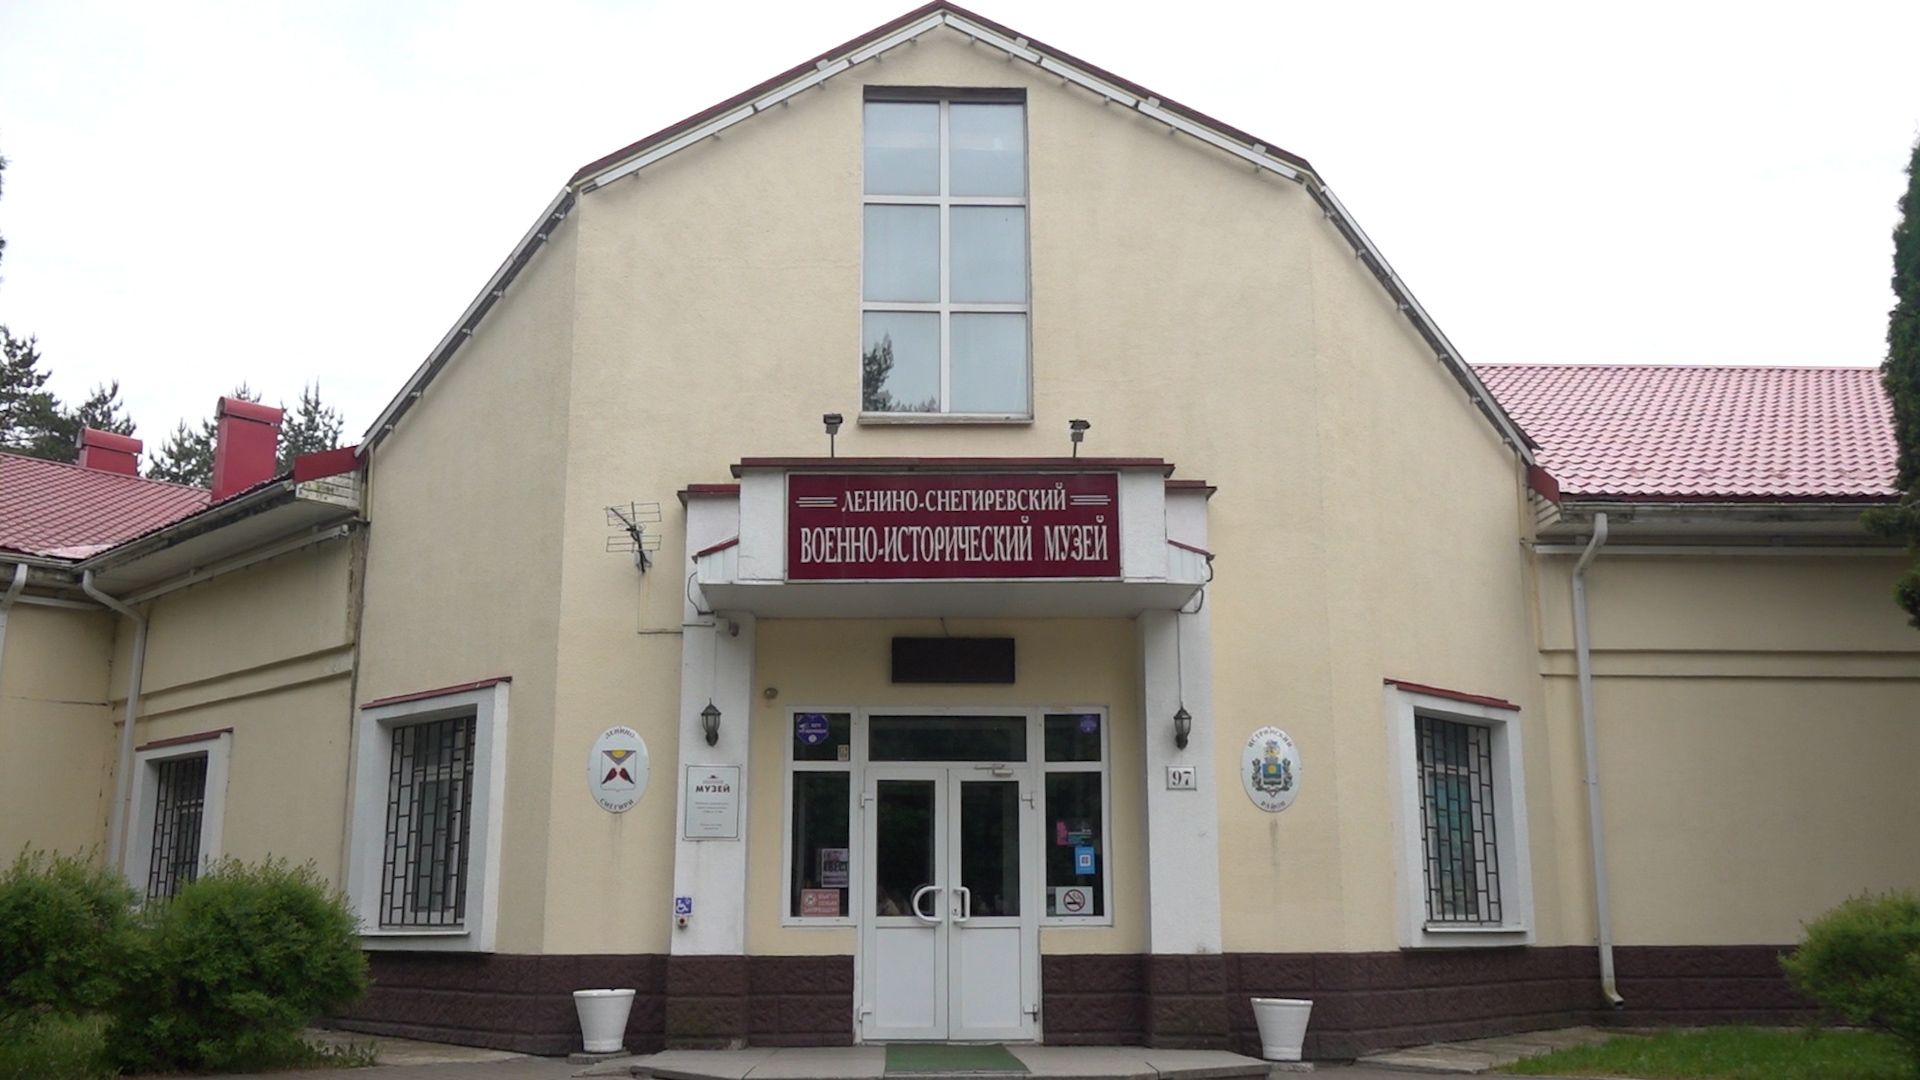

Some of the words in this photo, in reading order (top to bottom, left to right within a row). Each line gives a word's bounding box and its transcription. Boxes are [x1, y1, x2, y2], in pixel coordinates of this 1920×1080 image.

[842, 482, 1066, 512] ЛЕНИНО-СНЕГИРЕВСКИЙ
[800, 515, 1032, 563] ВОЕННО-ИСТОРИЧЕСКИЙ
[1044, 514, 1108, 561] МУЗЕЙ
[695, 784, 731, 793] МУЗЕЙ
[1172, 770, 1192, 786] 97
